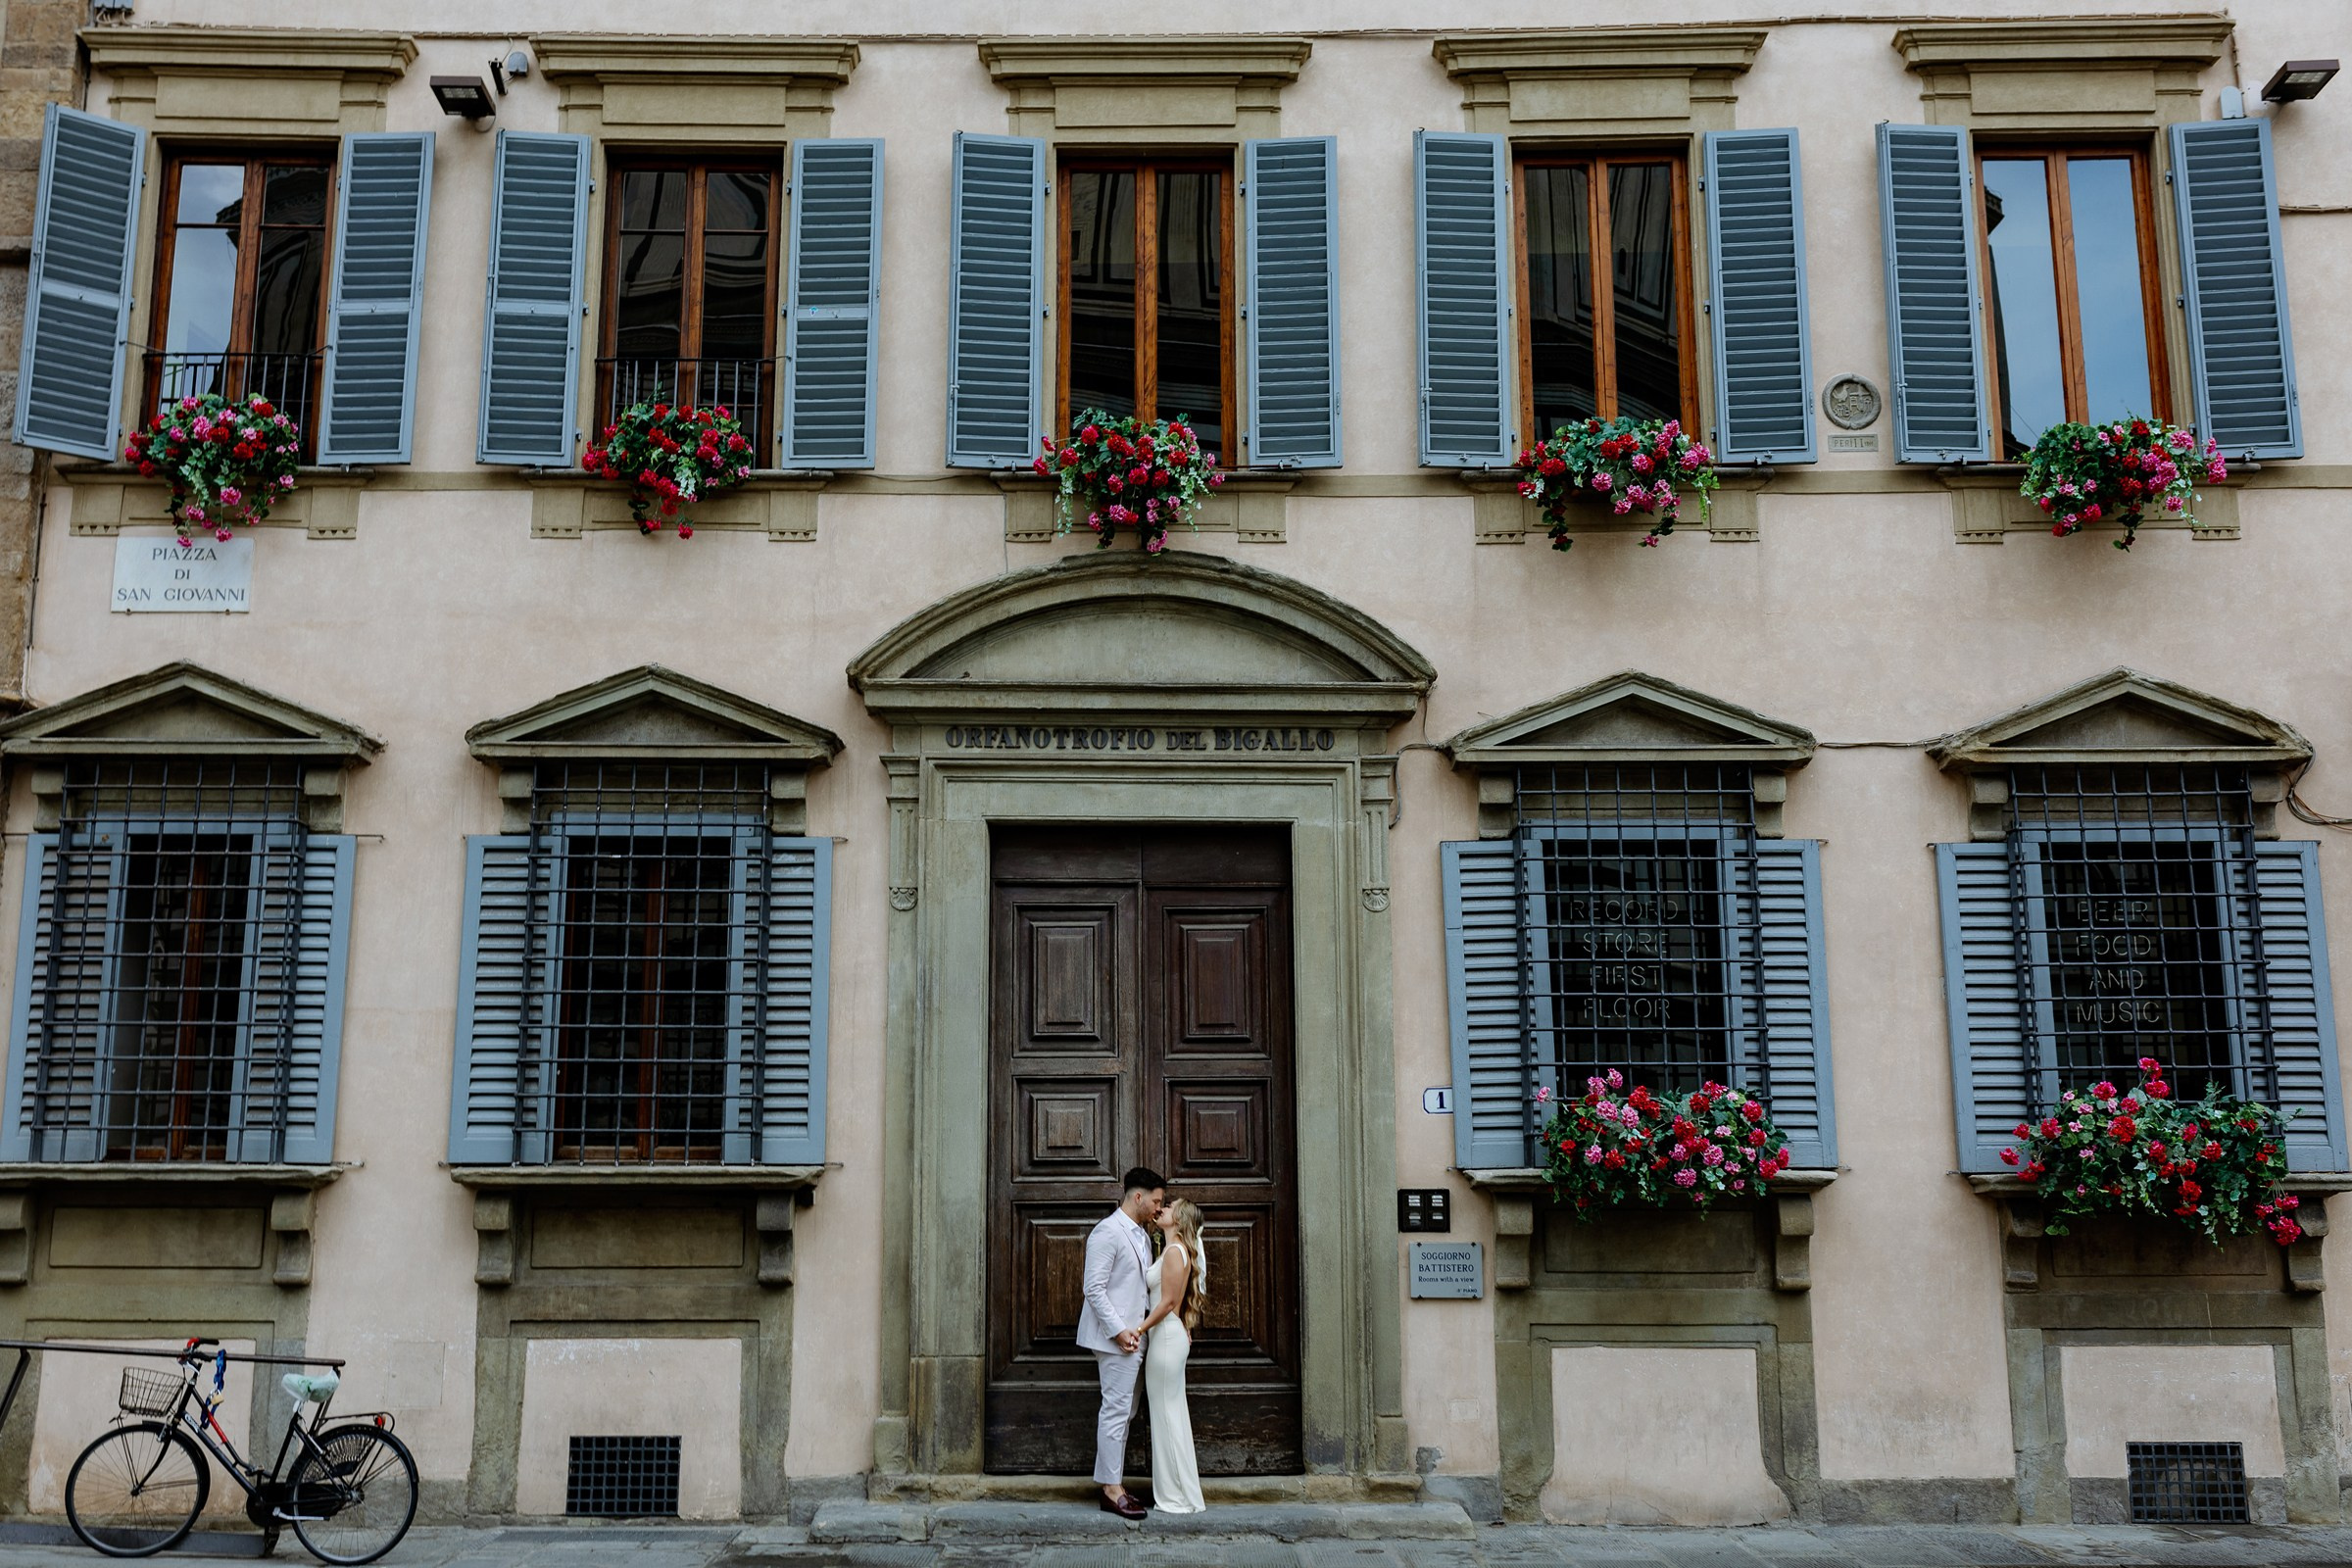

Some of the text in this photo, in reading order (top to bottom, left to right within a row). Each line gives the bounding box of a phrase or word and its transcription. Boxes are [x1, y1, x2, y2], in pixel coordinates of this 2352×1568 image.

[152, 547, 218, 561] PIAZZA
[174, 568, 191, 580] DI
[117, 587, 246, 602] SAN GIOVANNI
[945, 725, 1336, 752] ORFANOTROFIO DEL BIGALLO
[1570, 900, 1679, 921] RECORD
[2078, 901, 2148, 922] BEER
[1583, 933, 1668, 954] STORE
[2076, 935, 2151, 956] FOOD
[1590, 965, 1660, 986] FIRST
[2089, 969, 2144, 991] AND
[1584, 998, 1671, 1019] FLOOR
[2077, 1002, 2160, 1024] MUSIC
[1437, 1092, 1446, 1108] 1
